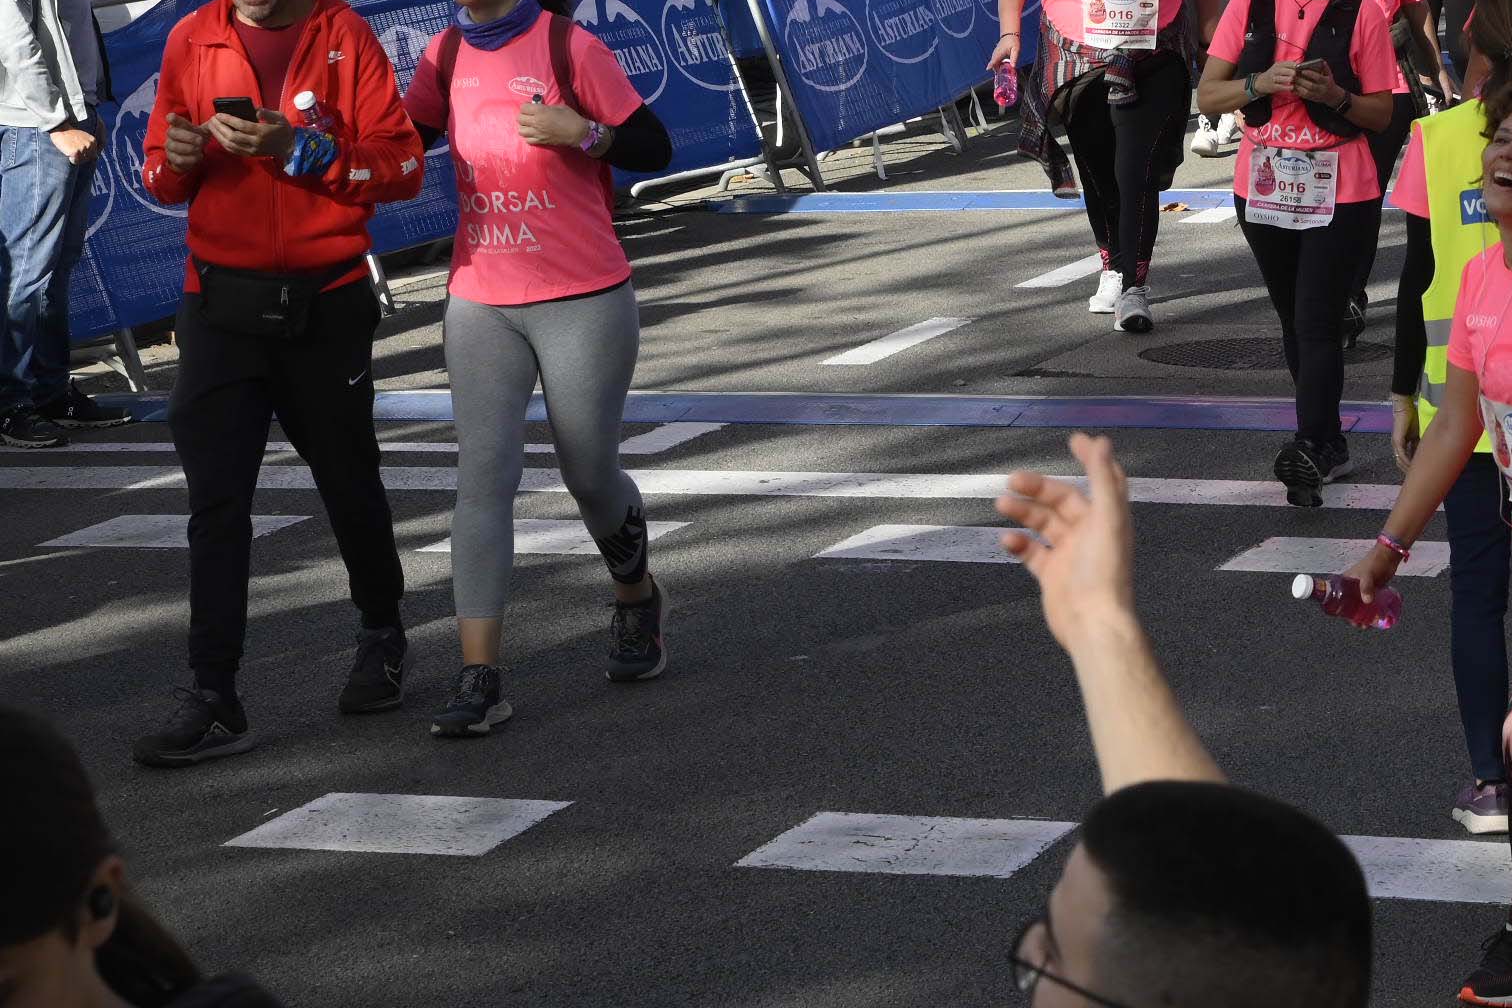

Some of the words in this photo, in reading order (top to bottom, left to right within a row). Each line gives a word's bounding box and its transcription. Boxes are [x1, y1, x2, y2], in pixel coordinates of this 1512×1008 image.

[1108, 10, 1133, 21] 016
[1278, 180, 1306, 194] 016
[463, 190, 557, 215] DORSAL
[467, 221, 538, 246] SUMA
